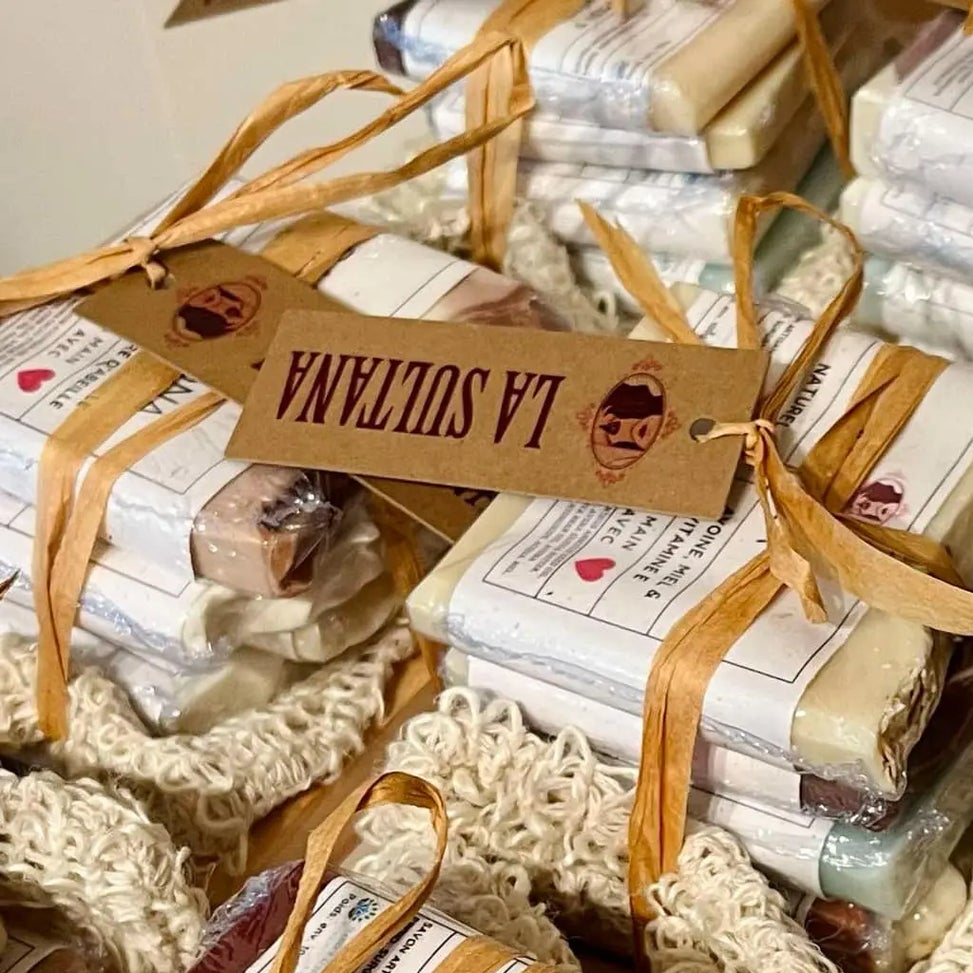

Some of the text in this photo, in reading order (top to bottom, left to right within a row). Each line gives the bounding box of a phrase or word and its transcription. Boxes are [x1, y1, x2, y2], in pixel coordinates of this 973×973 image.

[275, 350, 566, 450] LA SULTANA
[600, 508, 635, 544] AVEC
[622, 515, 657, 551] MAIN
[633, 573, 650, 582] E
[656, 564, 691, 586] MIEL
[644, 589, 661, 599] &
[400, 922, 433, 954] SAVON
